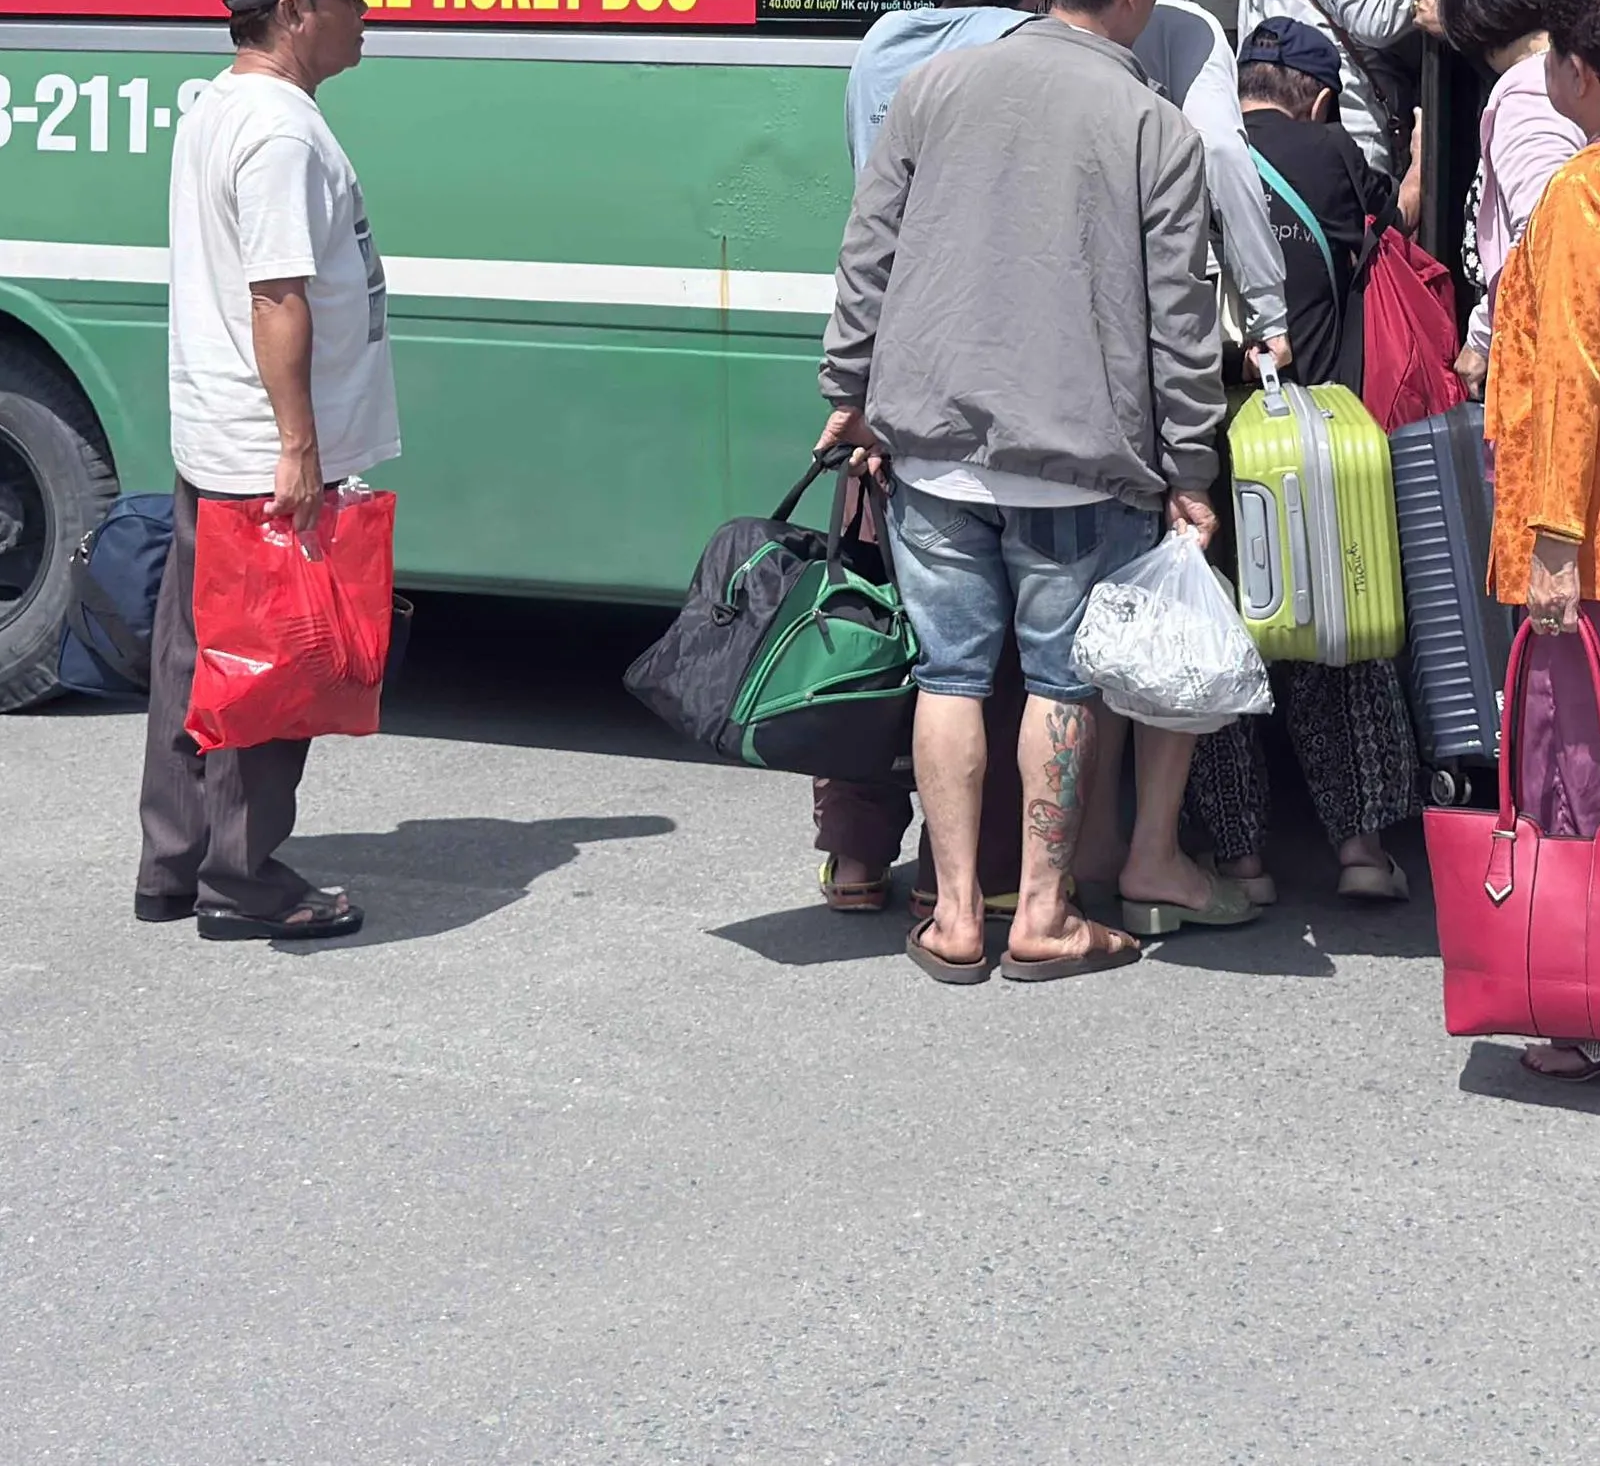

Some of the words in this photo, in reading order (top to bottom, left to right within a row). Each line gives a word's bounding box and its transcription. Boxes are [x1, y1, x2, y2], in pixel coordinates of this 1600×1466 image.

[841, 0, 855, 10] HK
[871, 0, 879, 12] ly
[1269, 222, 1315, 243] ept.v
